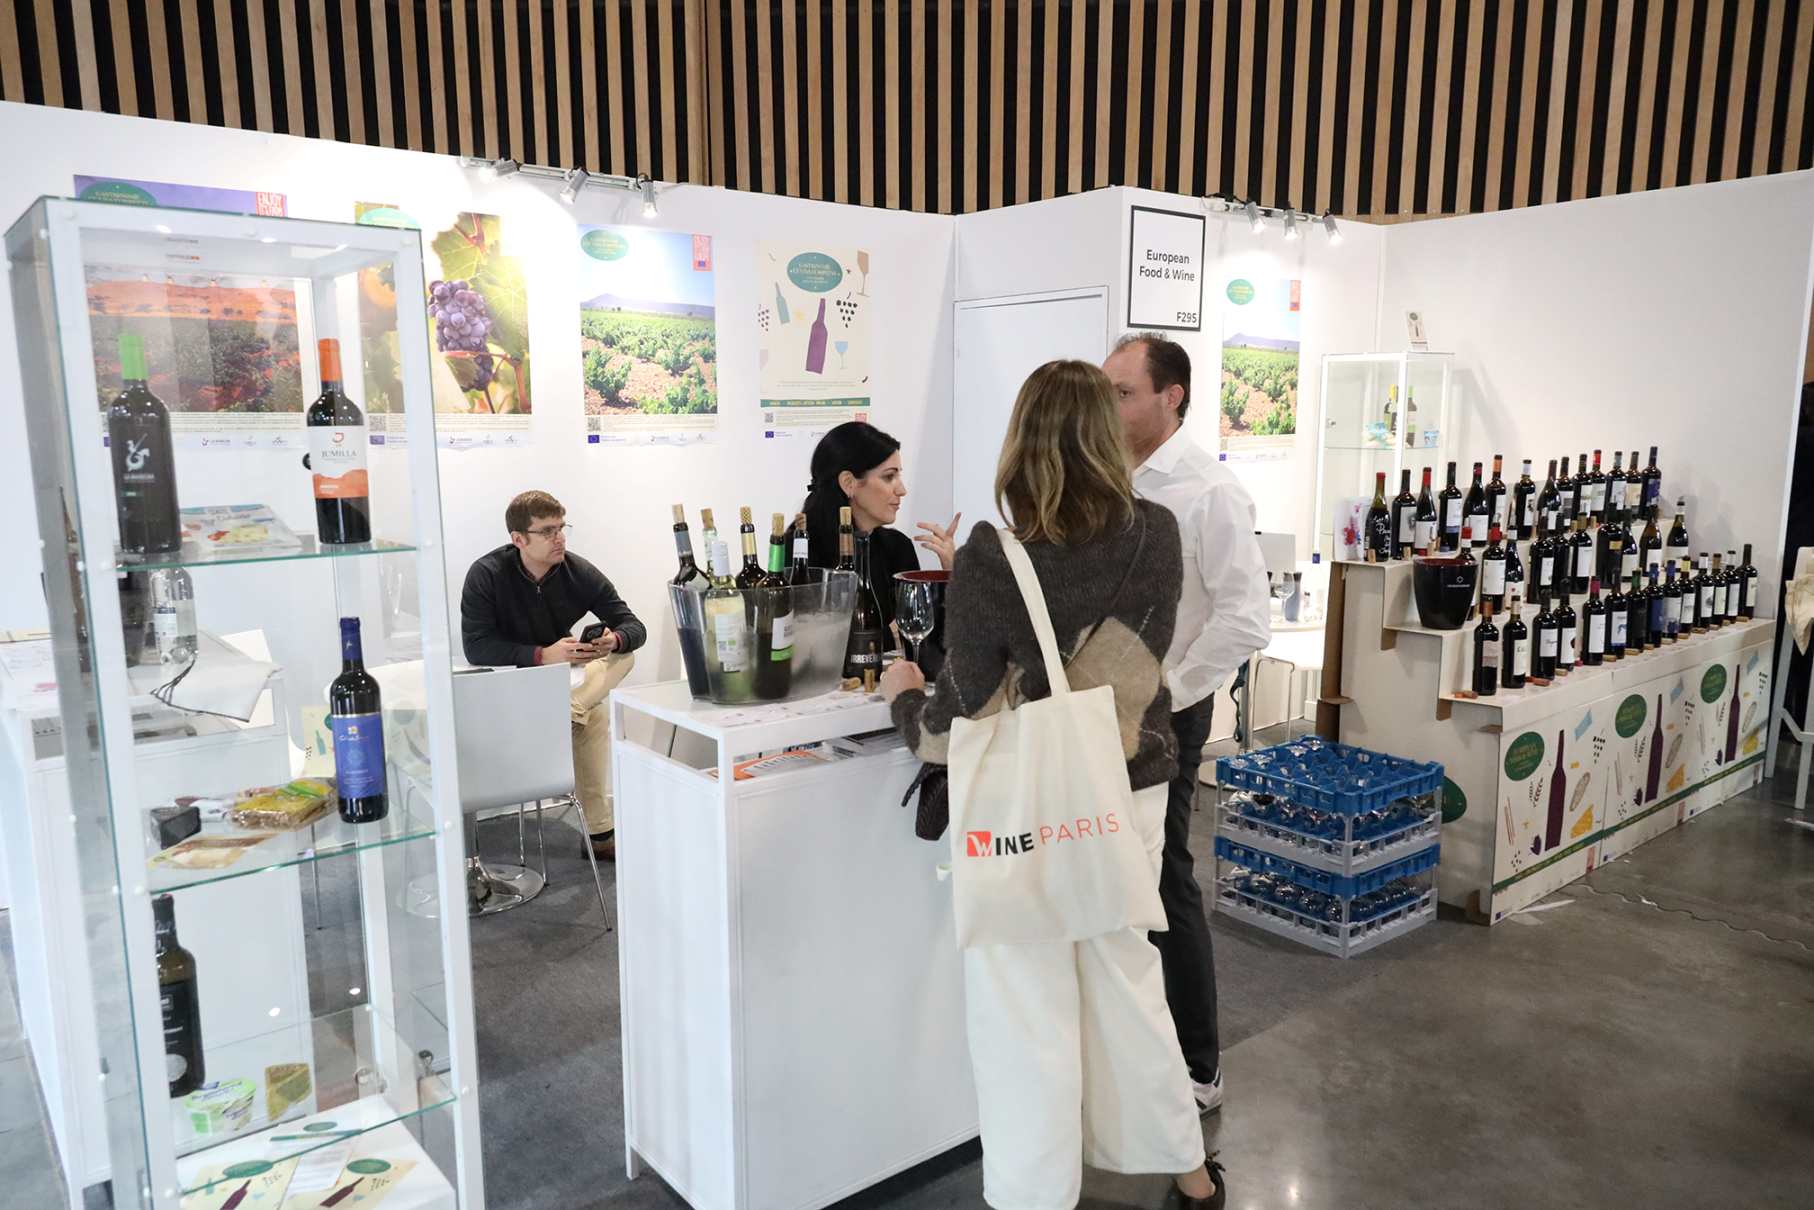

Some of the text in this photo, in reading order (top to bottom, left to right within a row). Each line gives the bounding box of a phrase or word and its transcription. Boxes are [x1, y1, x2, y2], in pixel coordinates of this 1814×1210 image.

[1146, 249, 1190, 265] European
[1139, 266, 1195, 281] Food & Wine
[321, 449, 357, 458] JUMILLA
[967, 812, 1120, 857] WINE PARIS
